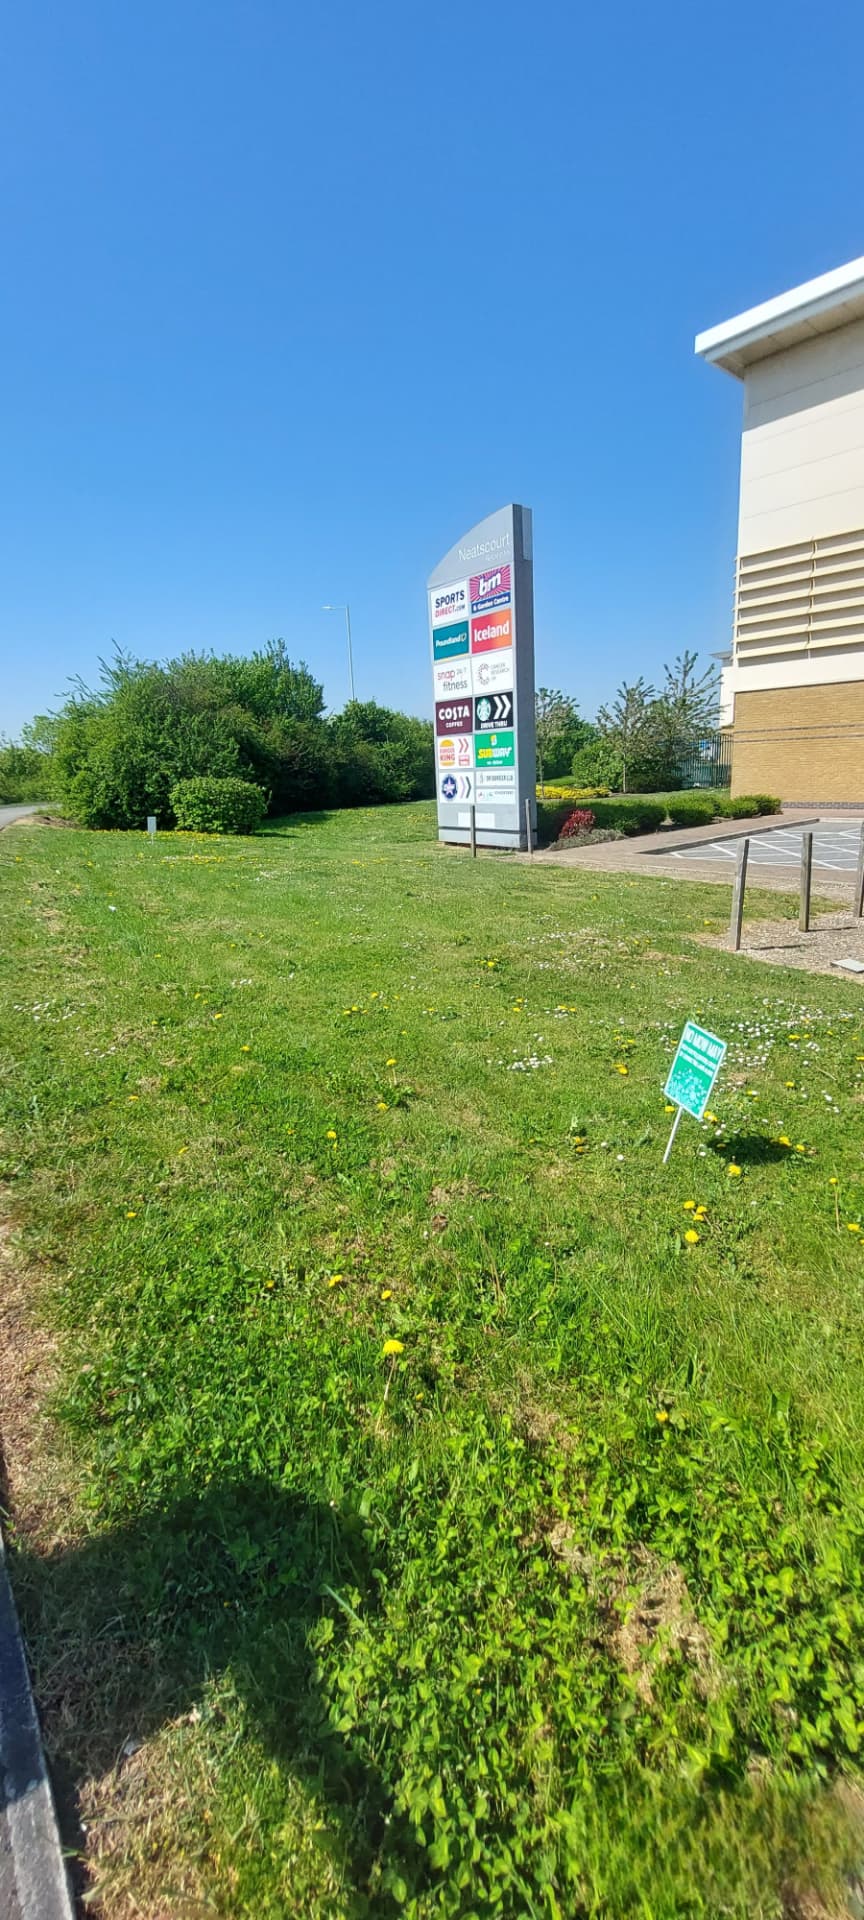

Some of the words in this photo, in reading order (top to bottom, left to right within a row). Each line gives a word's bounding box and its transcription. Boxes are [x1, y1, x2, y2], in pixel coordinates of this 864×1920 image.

[458, 533, 509, 560] Neatscourt
[435, 590, 465, 608] SPORTS
[474, 620, 510, 642] Iceland
[435, 633, 461, 647] Poundland
[437, 670, 455, 681] snap
[443, 680, 468, 691] fitness
[439, 705, 470, 720] COSTA
[477, 746, 512, 759] SUBWAY
[684, 1028, 695, 1043] NO
[692, 1032, 710, 1052] MOW
[706, 1042, 723, 1061] MAY
